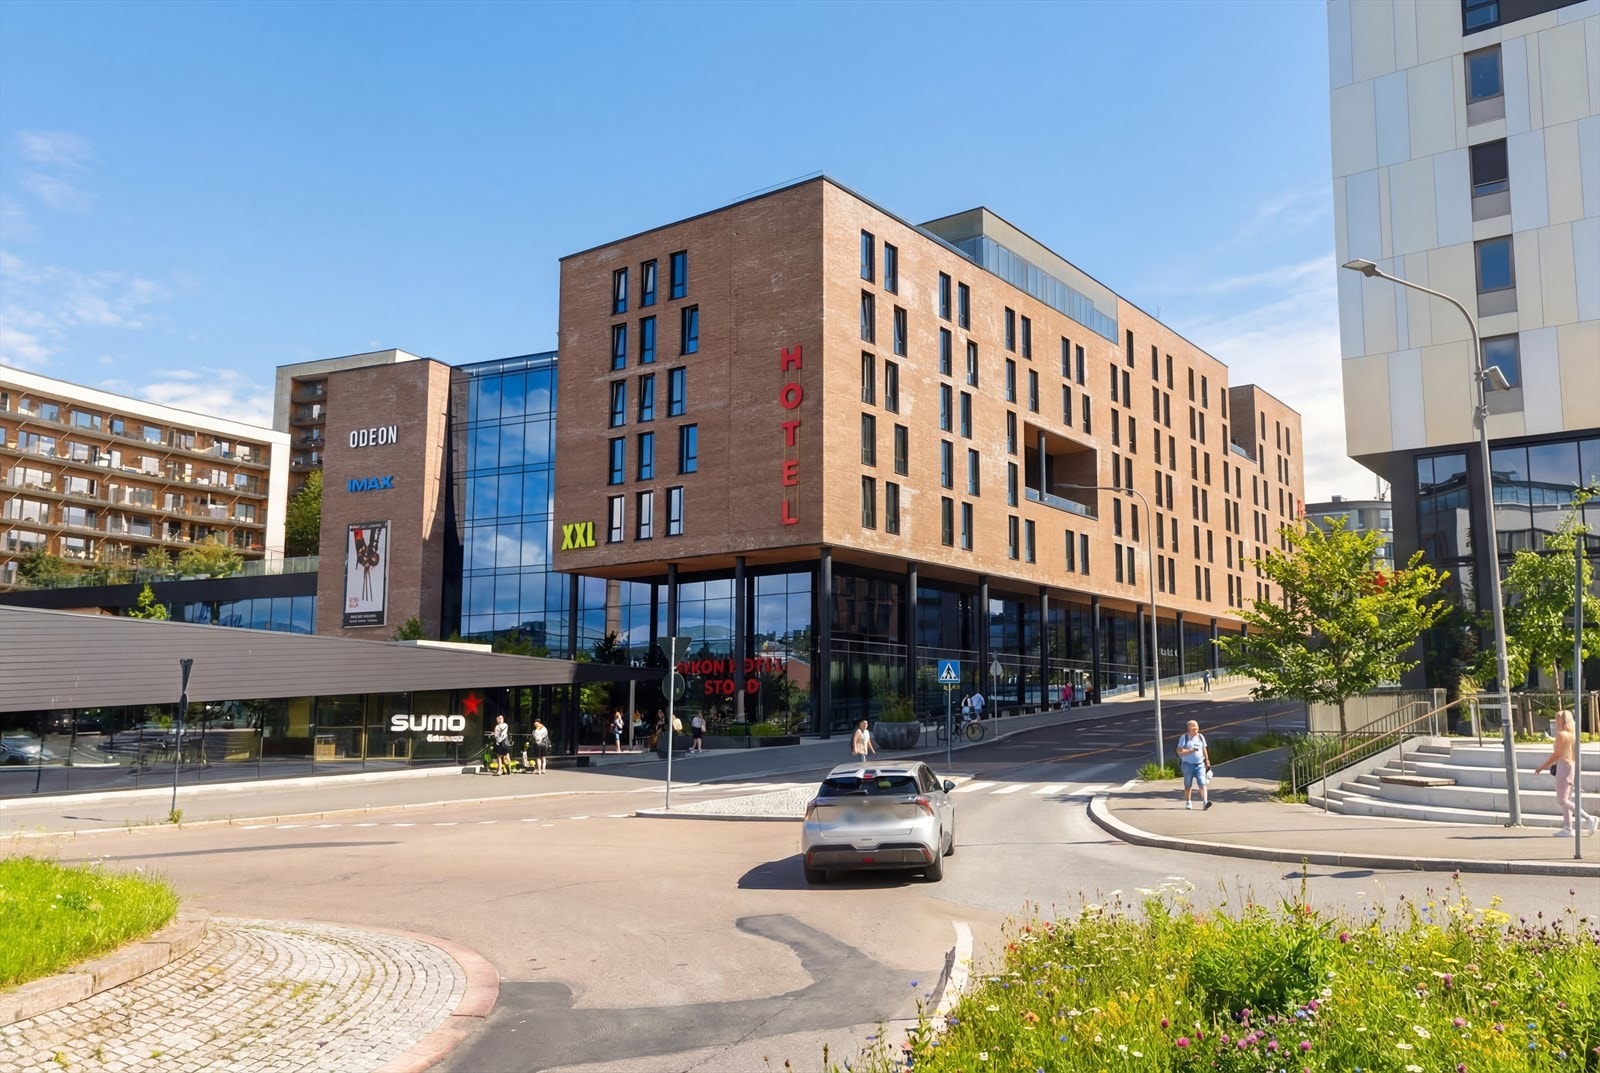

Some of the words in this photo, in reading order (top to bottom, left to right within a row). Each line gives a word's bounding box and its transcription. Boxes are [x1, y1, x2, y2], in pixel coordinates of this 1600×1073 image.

[350, 425, 397, 448] ODEON
[780, 345, 803, 525] HOTEL
[347, 475, 393, 492] IMAX
[561, 521, 596, 550] XXL
[390, 714, 466, 732] SUMO
